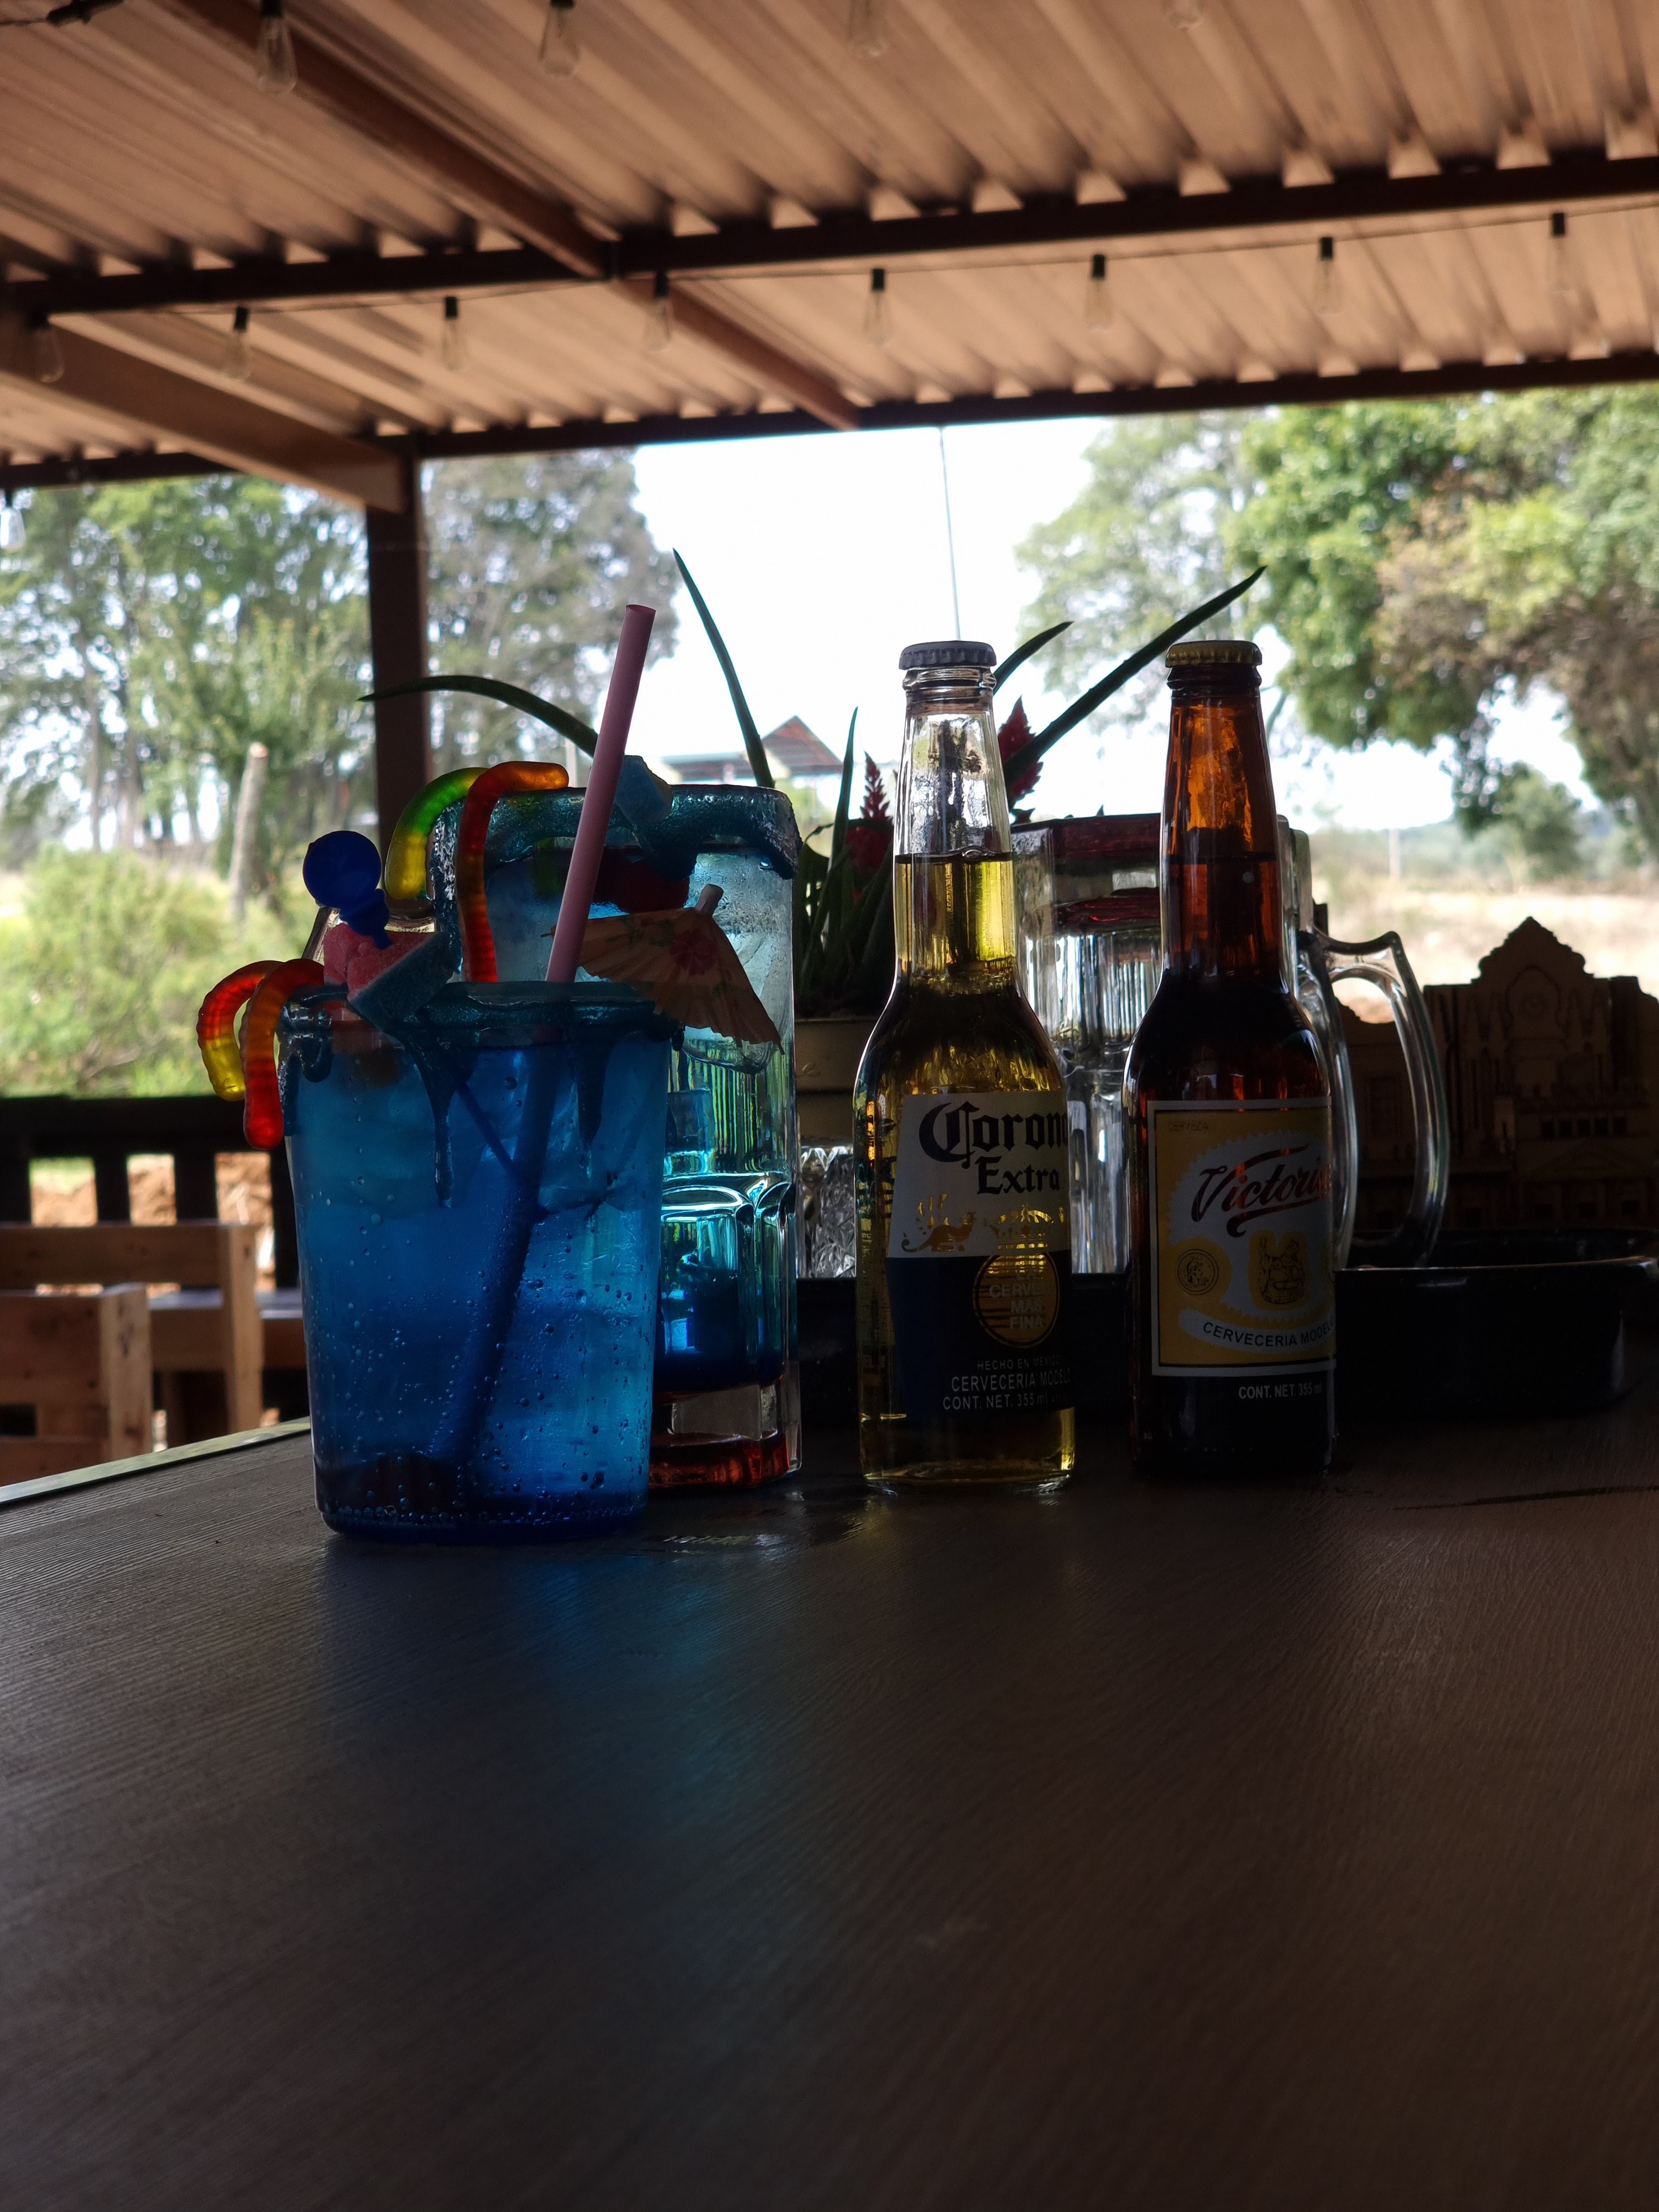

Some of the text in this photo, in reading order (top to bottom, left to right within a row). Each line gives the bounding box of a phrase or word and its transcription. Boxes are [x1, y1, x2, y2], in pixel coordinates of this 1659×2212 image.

[975, 1156, 1060, 1194] Extra
[1010, 1316, 1043, 1331] FINA
[1203, 1315, 1335, 1347] CERVECERIA MODELO
[977, 1359, 1014, 1370] HECHO
[1018, 1358, 1029, 1369] EN
[951, 1367, 1071, 1392] CERVECERIA MODELO
[943, 1396, 982, 1410] CONT.
[987, 1394, 1013, 1408] NET.
[1017, 1392, 1035, 1407] 355
[1037, 1391, 1048, 1405] ml
[1239, 1384, 1272, 1400] CONT.
[1275, 1383, 1296, 1398] NET.
[1298, 1382, 1313, 1396] 355
